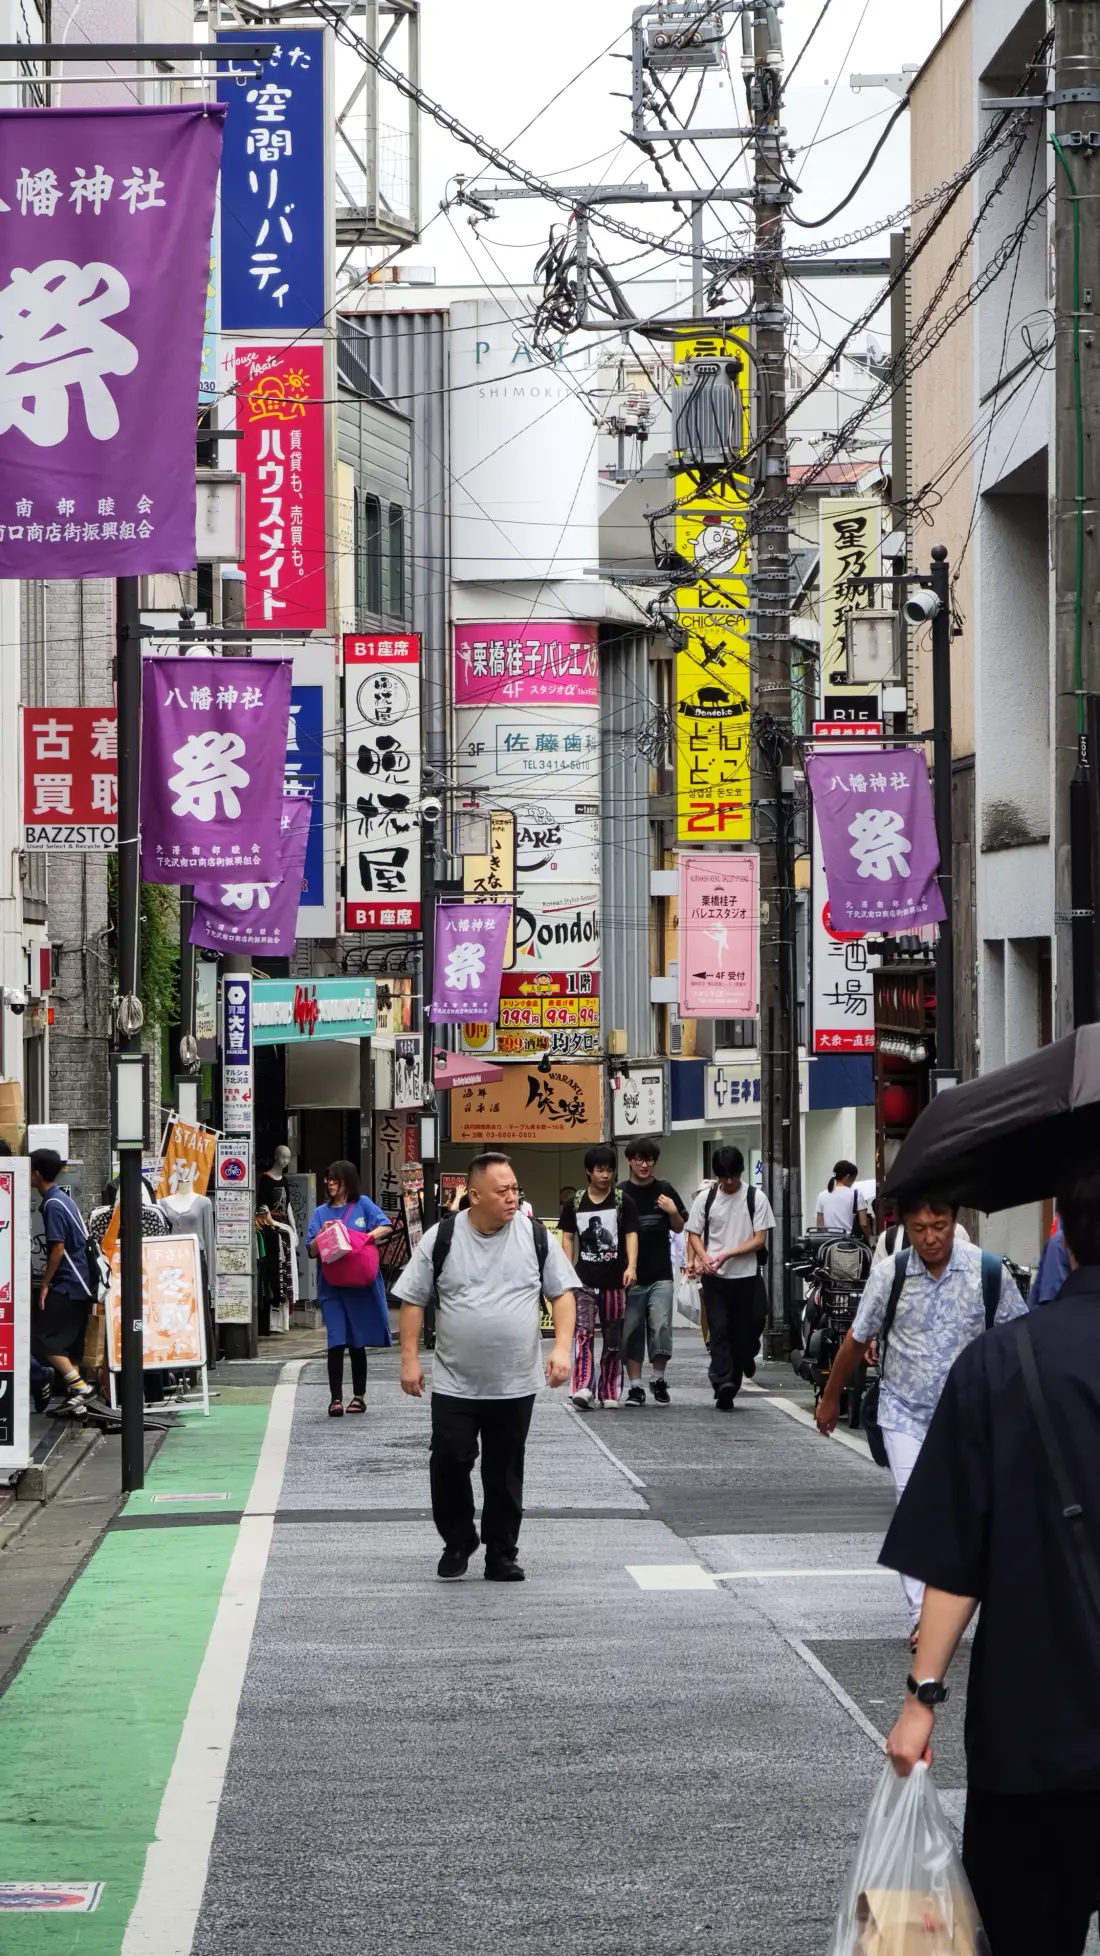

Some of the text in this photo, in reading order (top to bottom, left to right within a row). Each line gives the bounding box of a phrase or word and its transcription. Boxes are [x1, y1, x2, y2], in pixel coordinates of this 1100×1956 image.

[0, 165, 166, 217] 幡神社
[245, 83, 295, 308] 空間リバティ
[0, 260, 138, 448] 祭
[221, 352, 259, 372] House
[256, 429, 287, 621] ハウスメイト
[164, 685, 264, 711] 八幡神社
[502, 681, 524, 698] 4F
[32, 718, 118, 760] 古着
[468, 742, 485, 757] 3F
[690, 721, 742, 752] どん
[168, 730, 250, 822] 祭
[690, 755, 741, 785] どこ
[831, 772, 910, 793] 八幡神社
[32, 773, 118, 815] 買取
[687, 802, 743, 832] 2F
[26, 826, 115, 843] BAZZSTO
[848, 808, 912, 881] 祭
[691, 908, 747, 919] バレエスタジオ
[702, 896, 737, 906] 栗橋桂子
[445, 918, 496, 932] 八幡神社
[444, 942, 486, 990] 祭
[716, 971, 746, 981] 4F 受付
[566, 973, 592, 994] 1階
[502, 1007, 541, 1025] 199円
[545, 1007, 577, 1025] 99円
[228, 1015, 246, 1047] 大吉
[548, 1071, 584, 1096] WARAKU
